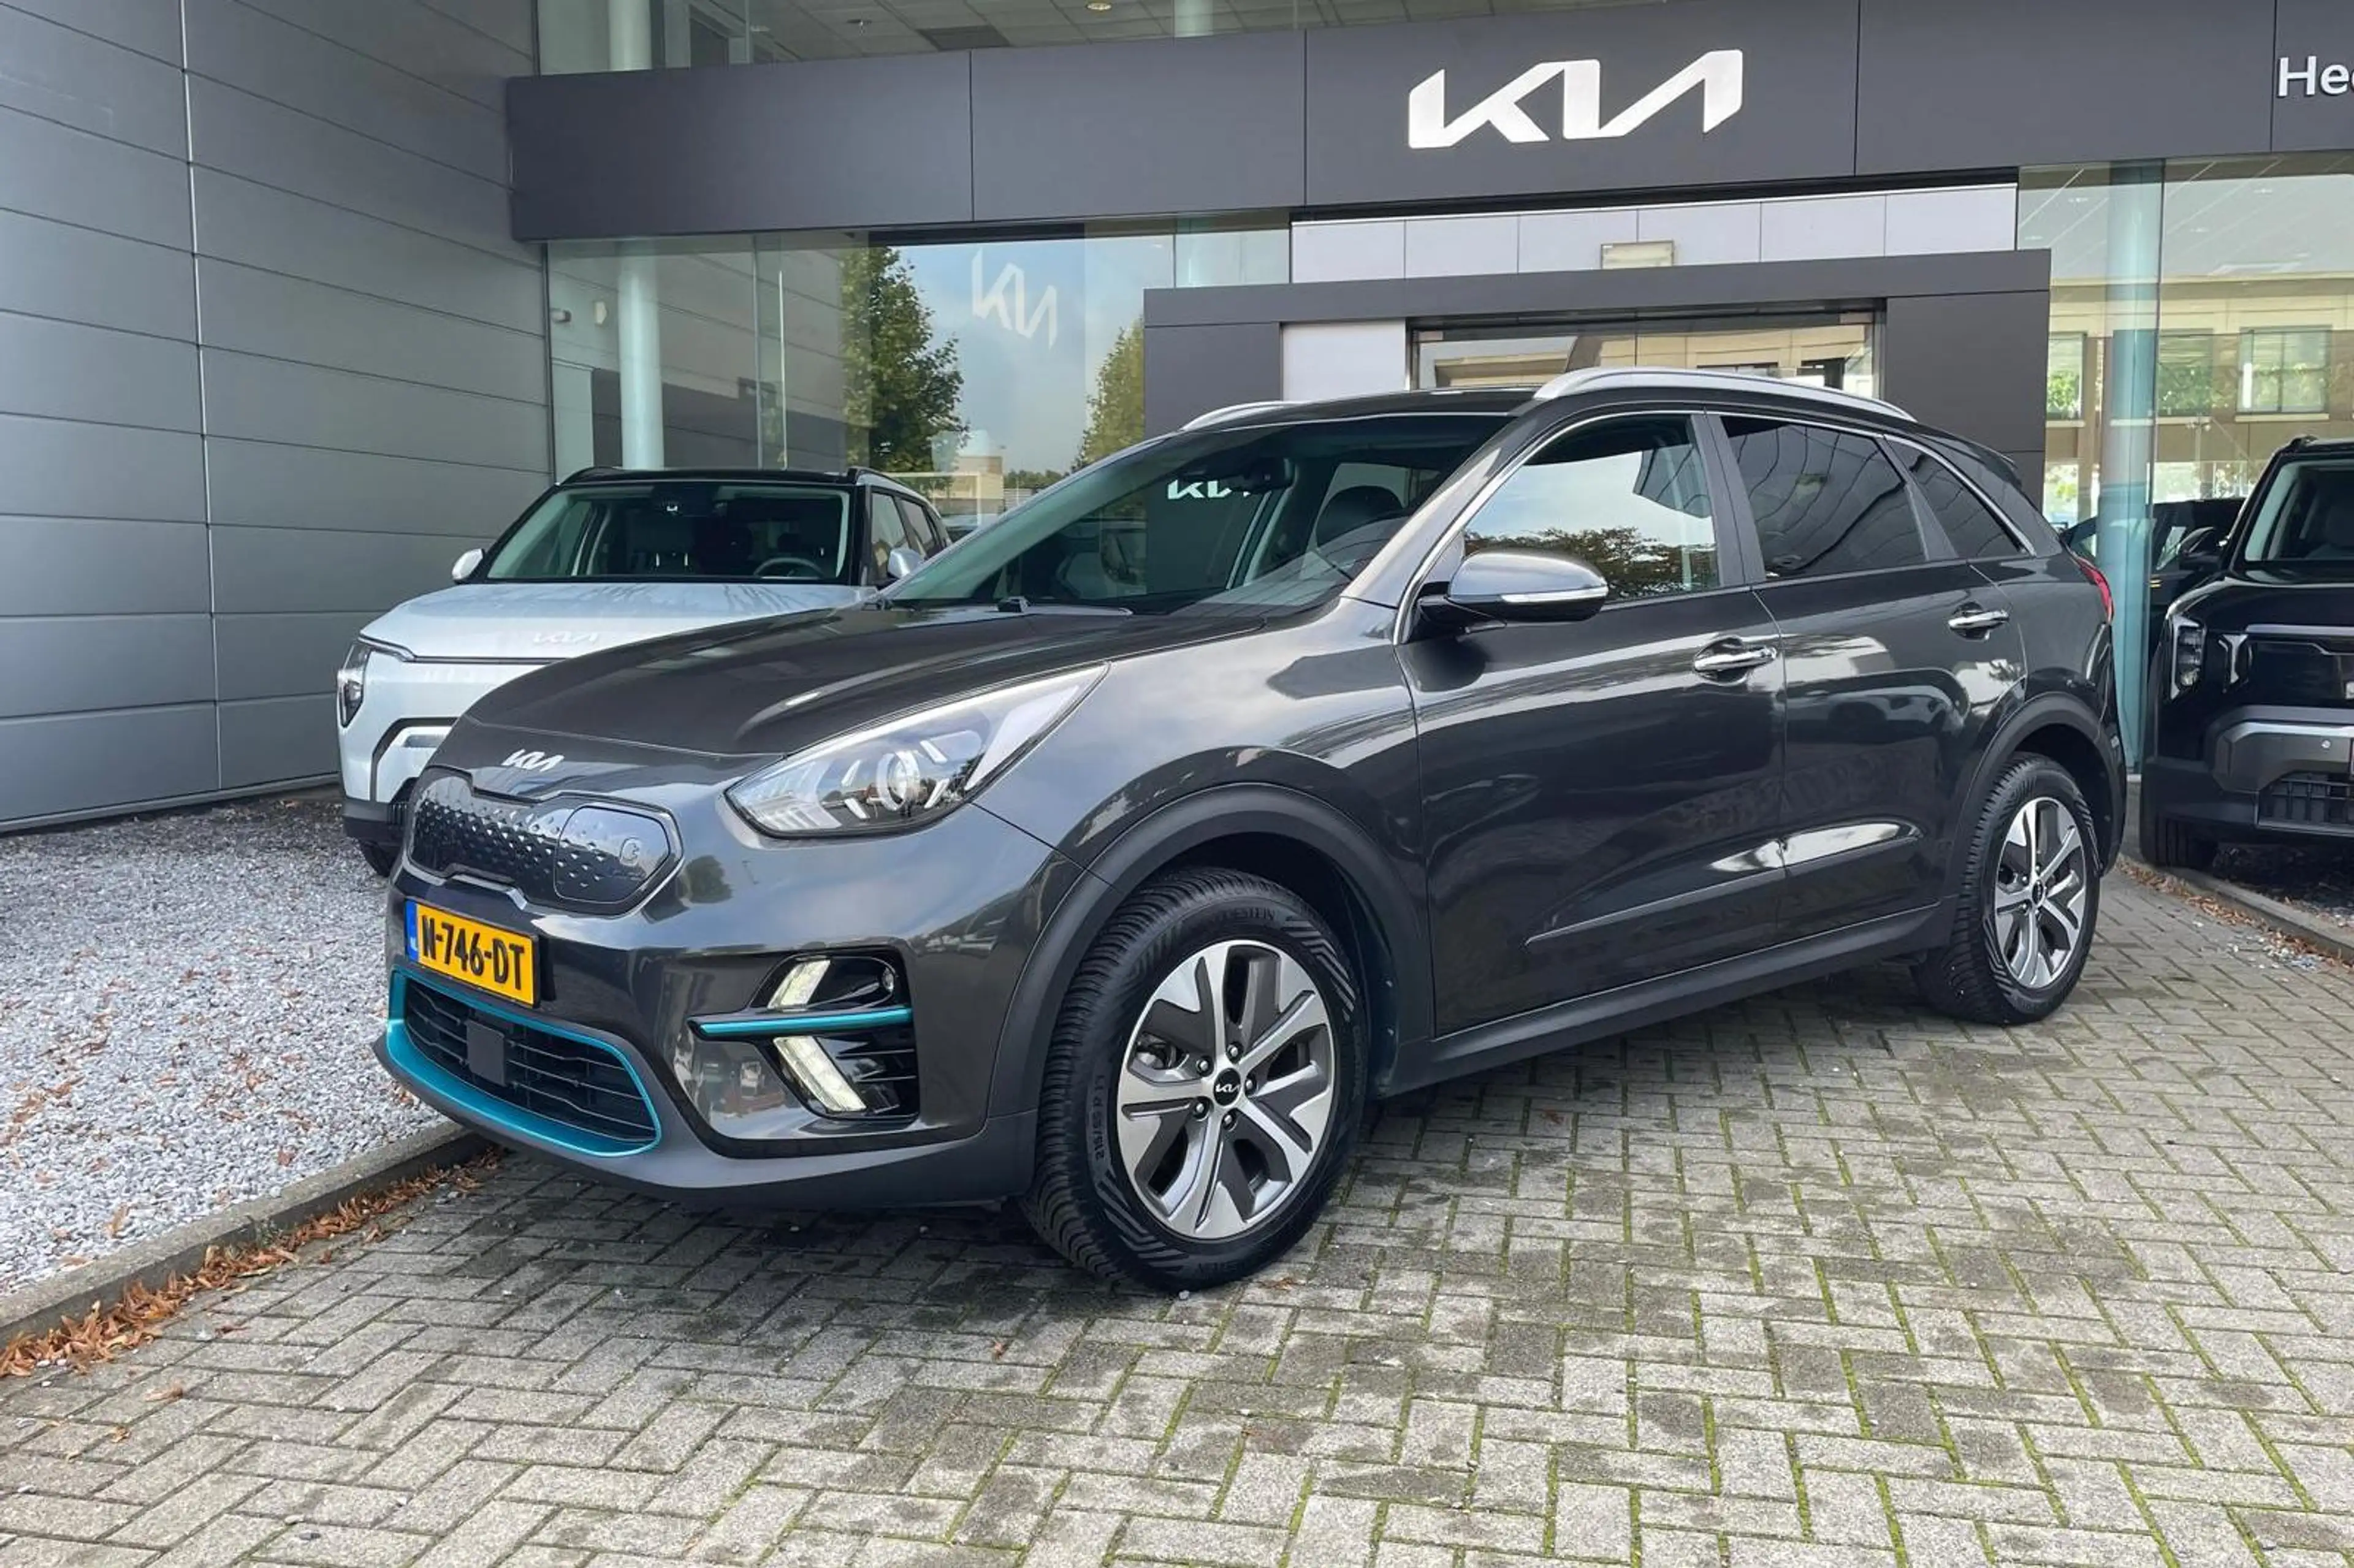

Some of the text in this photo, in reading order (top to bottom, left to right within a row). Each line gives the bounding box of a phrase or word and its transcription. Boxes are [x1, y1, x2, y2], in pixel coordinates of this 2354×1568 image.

[1409, 49, 1743, 150] KIA
[2278, 55, 2354, 97] He
[971, 246, 1058, 351] KIA
[501, 748, 565, 772] KIA
[421, 915, 525, 991] N-746-DT
[1215, 1083, 1241, 1094] KIA
